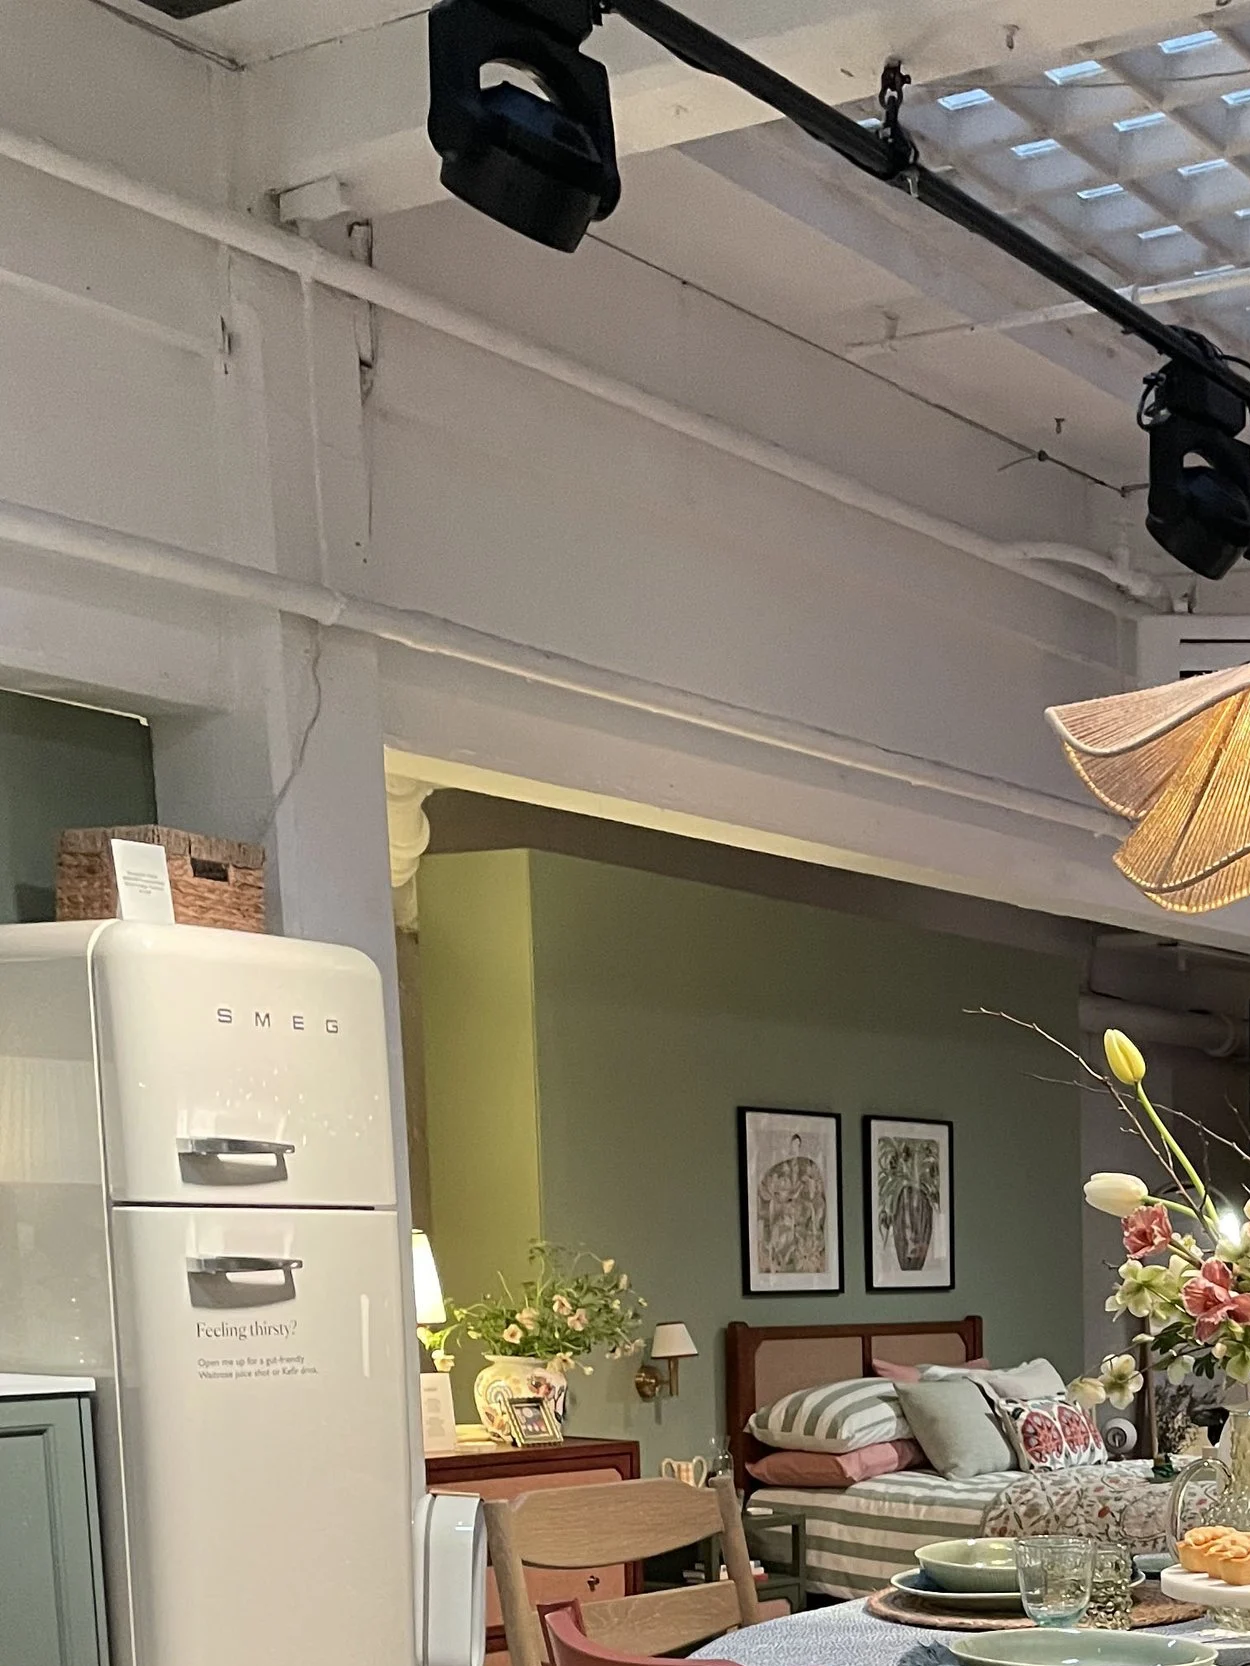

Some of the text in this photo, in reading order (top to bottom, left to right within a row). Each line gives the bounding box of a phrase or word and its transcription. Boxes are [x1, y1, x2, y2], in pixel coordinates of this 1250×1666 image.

[217, 1008, 339, 1034] SMEG
[196, 1320, 298, 1341] Feeling thirsty?
[198, 1358, 220, 1368] Open
[236, 1359, 246, 1367] up
[247, 1356, 258, 1365] for
